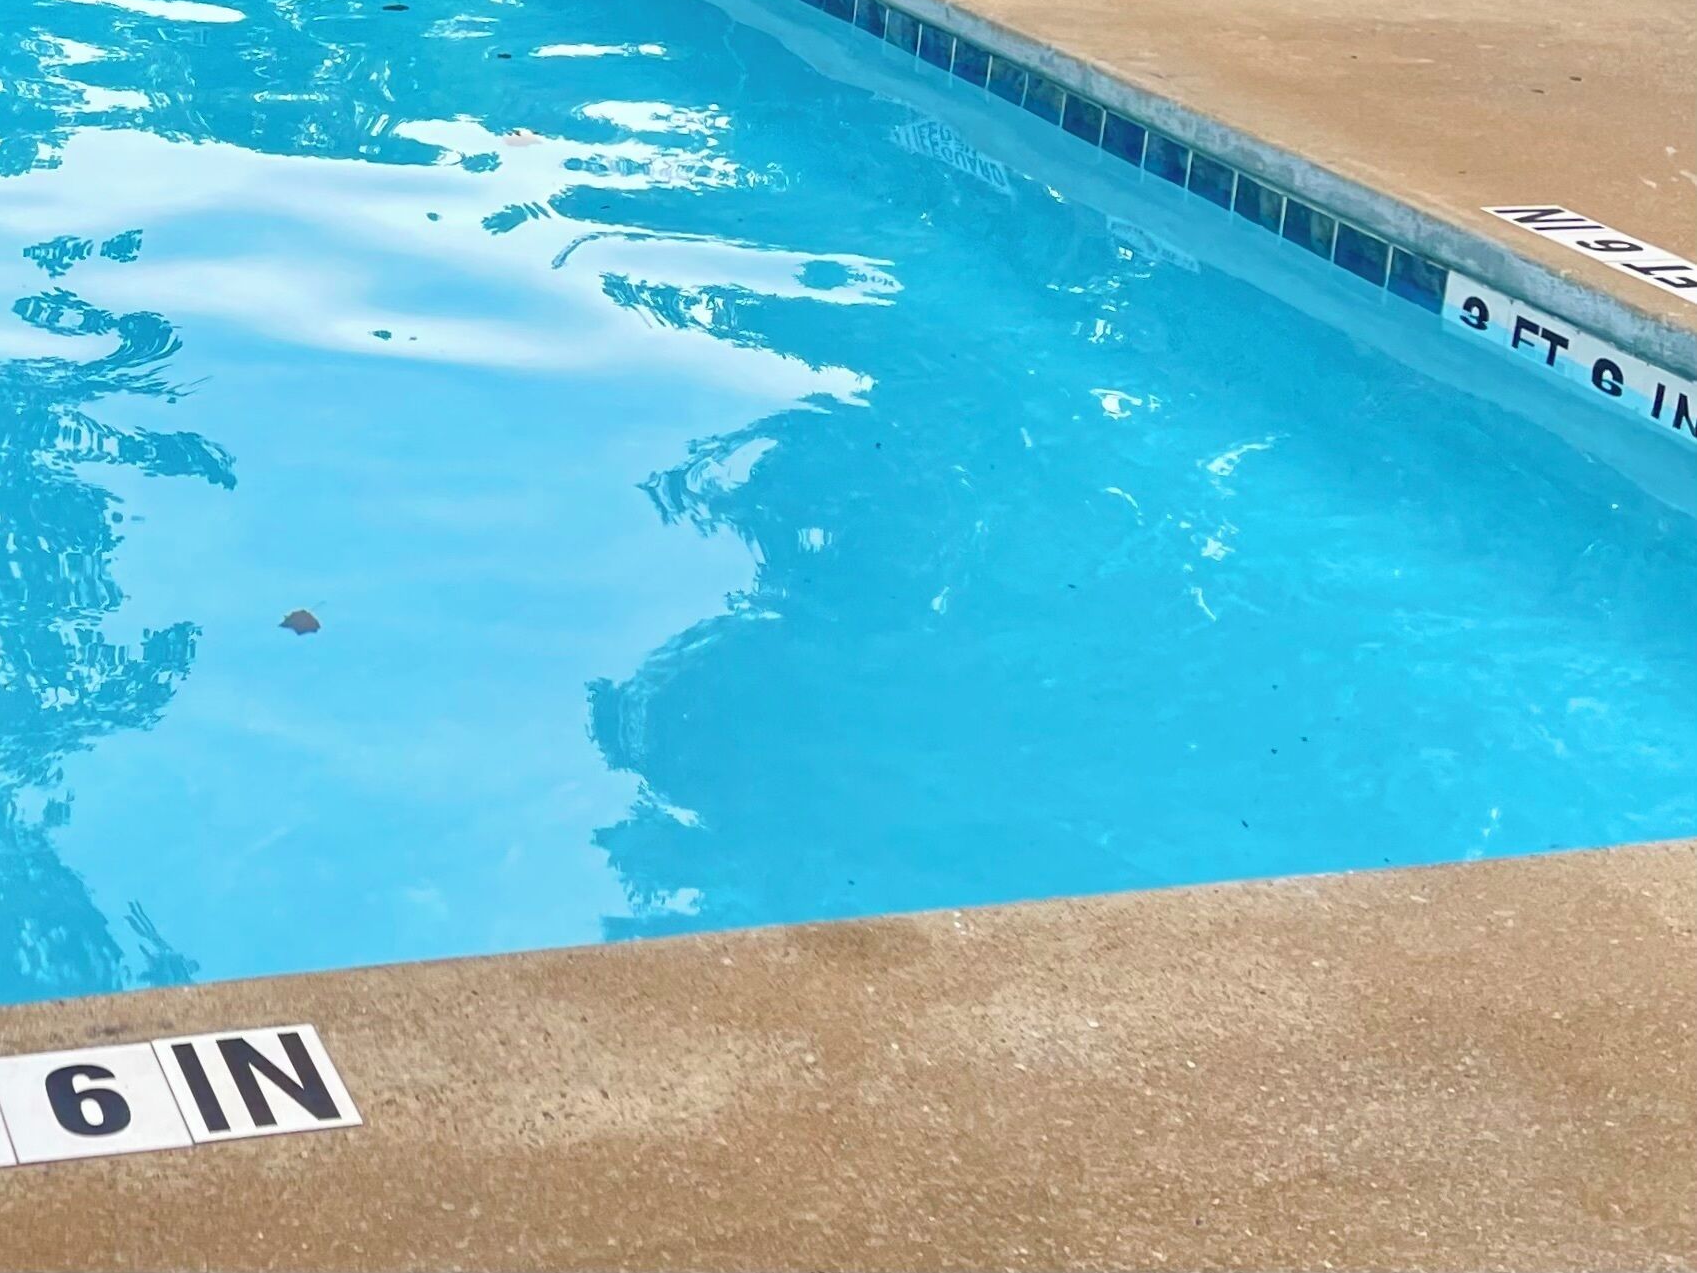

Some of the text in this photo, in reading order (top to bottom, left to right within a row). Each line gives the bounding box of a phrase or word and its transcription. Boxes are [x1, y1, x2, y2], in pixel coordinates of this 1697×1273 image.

[1511, 315, 1570, 367] FT
[1591, 358, 1625, 398] 6
[43, 1063, 132, 1137] 6
[170, 1031, 341, 1132] IN
